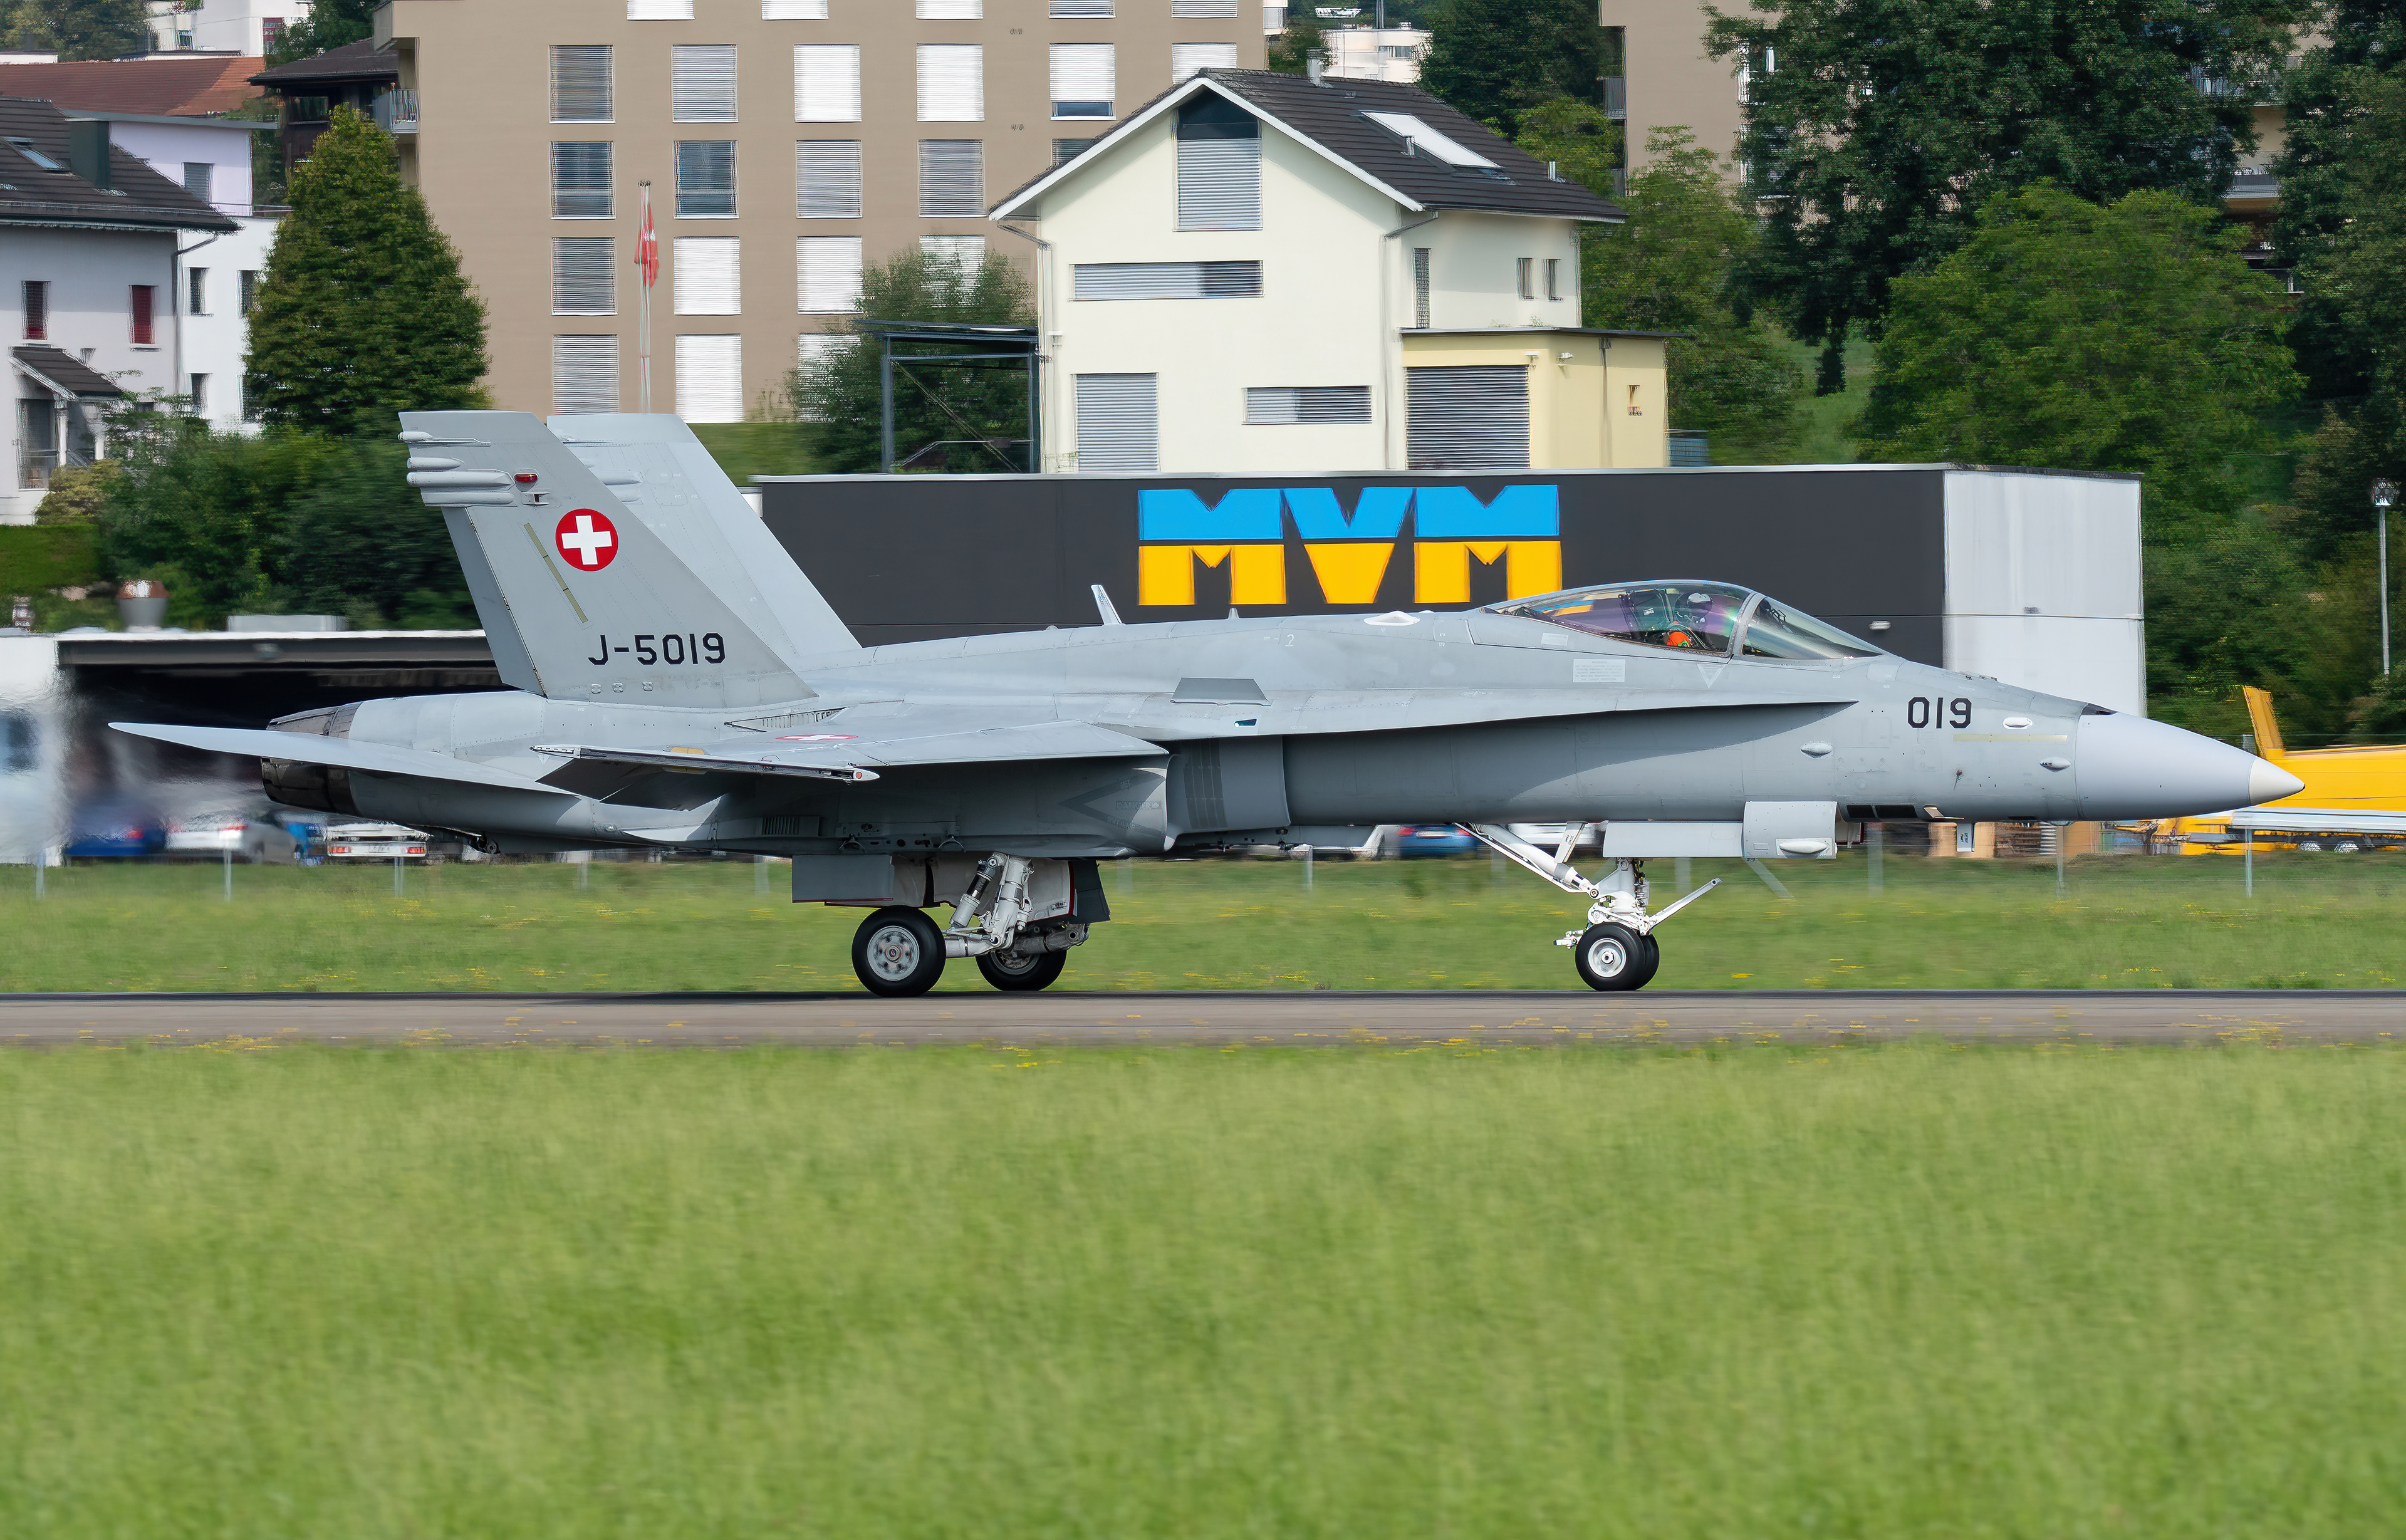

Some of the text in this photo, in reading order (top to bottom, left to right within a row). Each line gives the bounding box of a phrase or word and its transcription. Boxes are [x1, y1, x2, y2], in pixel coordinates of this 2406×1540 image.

[1137, 484, 1562, 606] MVM
[588, 632, 726, 665] J-5019
[1907, 696, 1972, 729] 019
